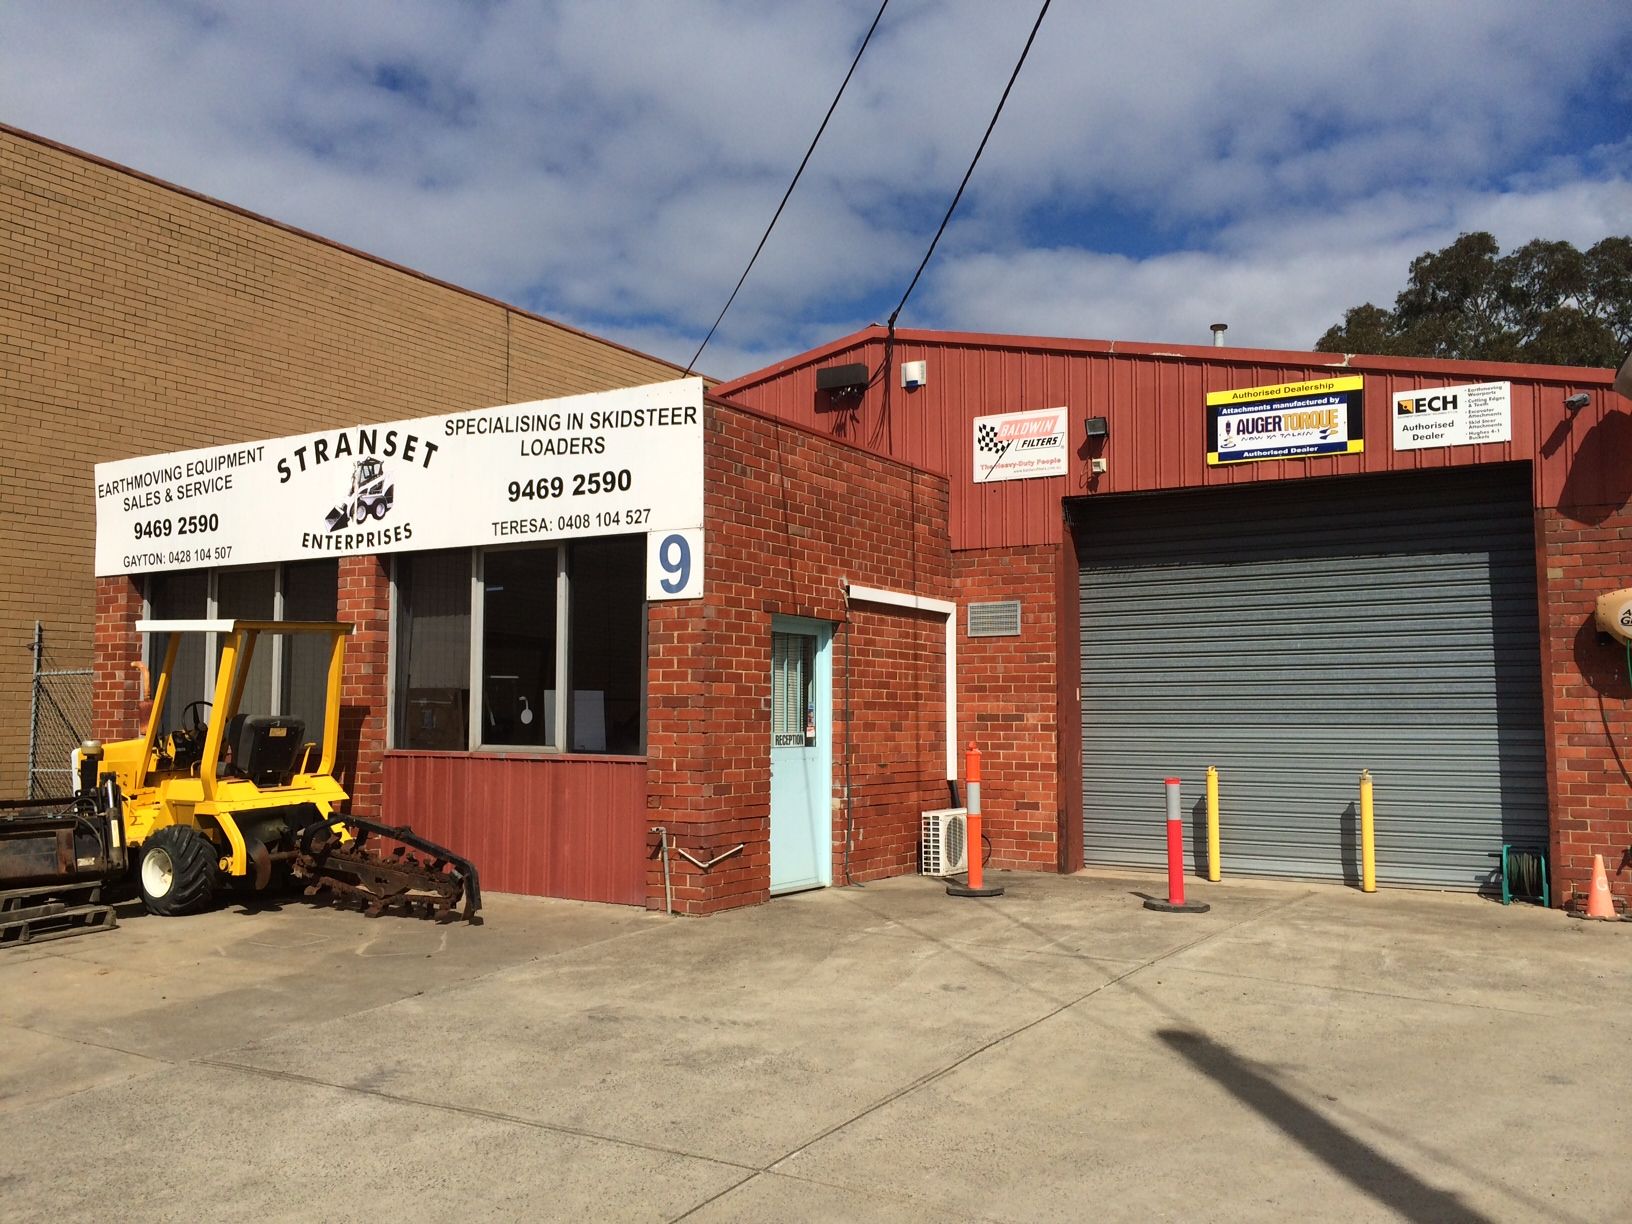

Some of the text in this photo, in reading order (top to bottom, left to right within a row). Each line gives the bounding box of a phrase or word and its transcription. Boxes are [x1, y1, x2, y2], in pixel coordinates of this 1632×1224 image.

[1231, 382, 1335, 400] Authorised Dealership
[1221, 396, 1340, 415] Attachments manufactured by
[1415, 394, 1458, 413] ECH
[445, 406, 697, 436] SPECIALISING IN SKIDSTEER
[1001, 420, 1054, 436] BALDWIN
[1402, 420, 1454, 432] Authorised
[521, 436, 606, 456] LOADERS
[1021, 436, 1059, 448] FILTERS
[1412, 432, 1445, 441] Dealer
[277, 429, 438, 484] STRANSET
[1243, 445, 1319, 458] Authorised Dealer
[98, 446, 265, 499] EARTHMOVING EQUIPMENT
[980, 463, 993, 471] The
[1036, 457, 1061, 466] People
[123, 474, 233, 512] SALES & SERVICE
[508, 469, 632, 502] 9469 2590
[134, 513, 219, 540] 9469 2590
[492, 508, 651, 536] TERESA: 0408 104 527
[302, 522, 413, 550] ENTERPRISES
[123, 546, 232, 568] GAYTON: 0428 104 507
[659, 533, 692, 594] 9
[775, 734, 804, 746] RECEPTION
